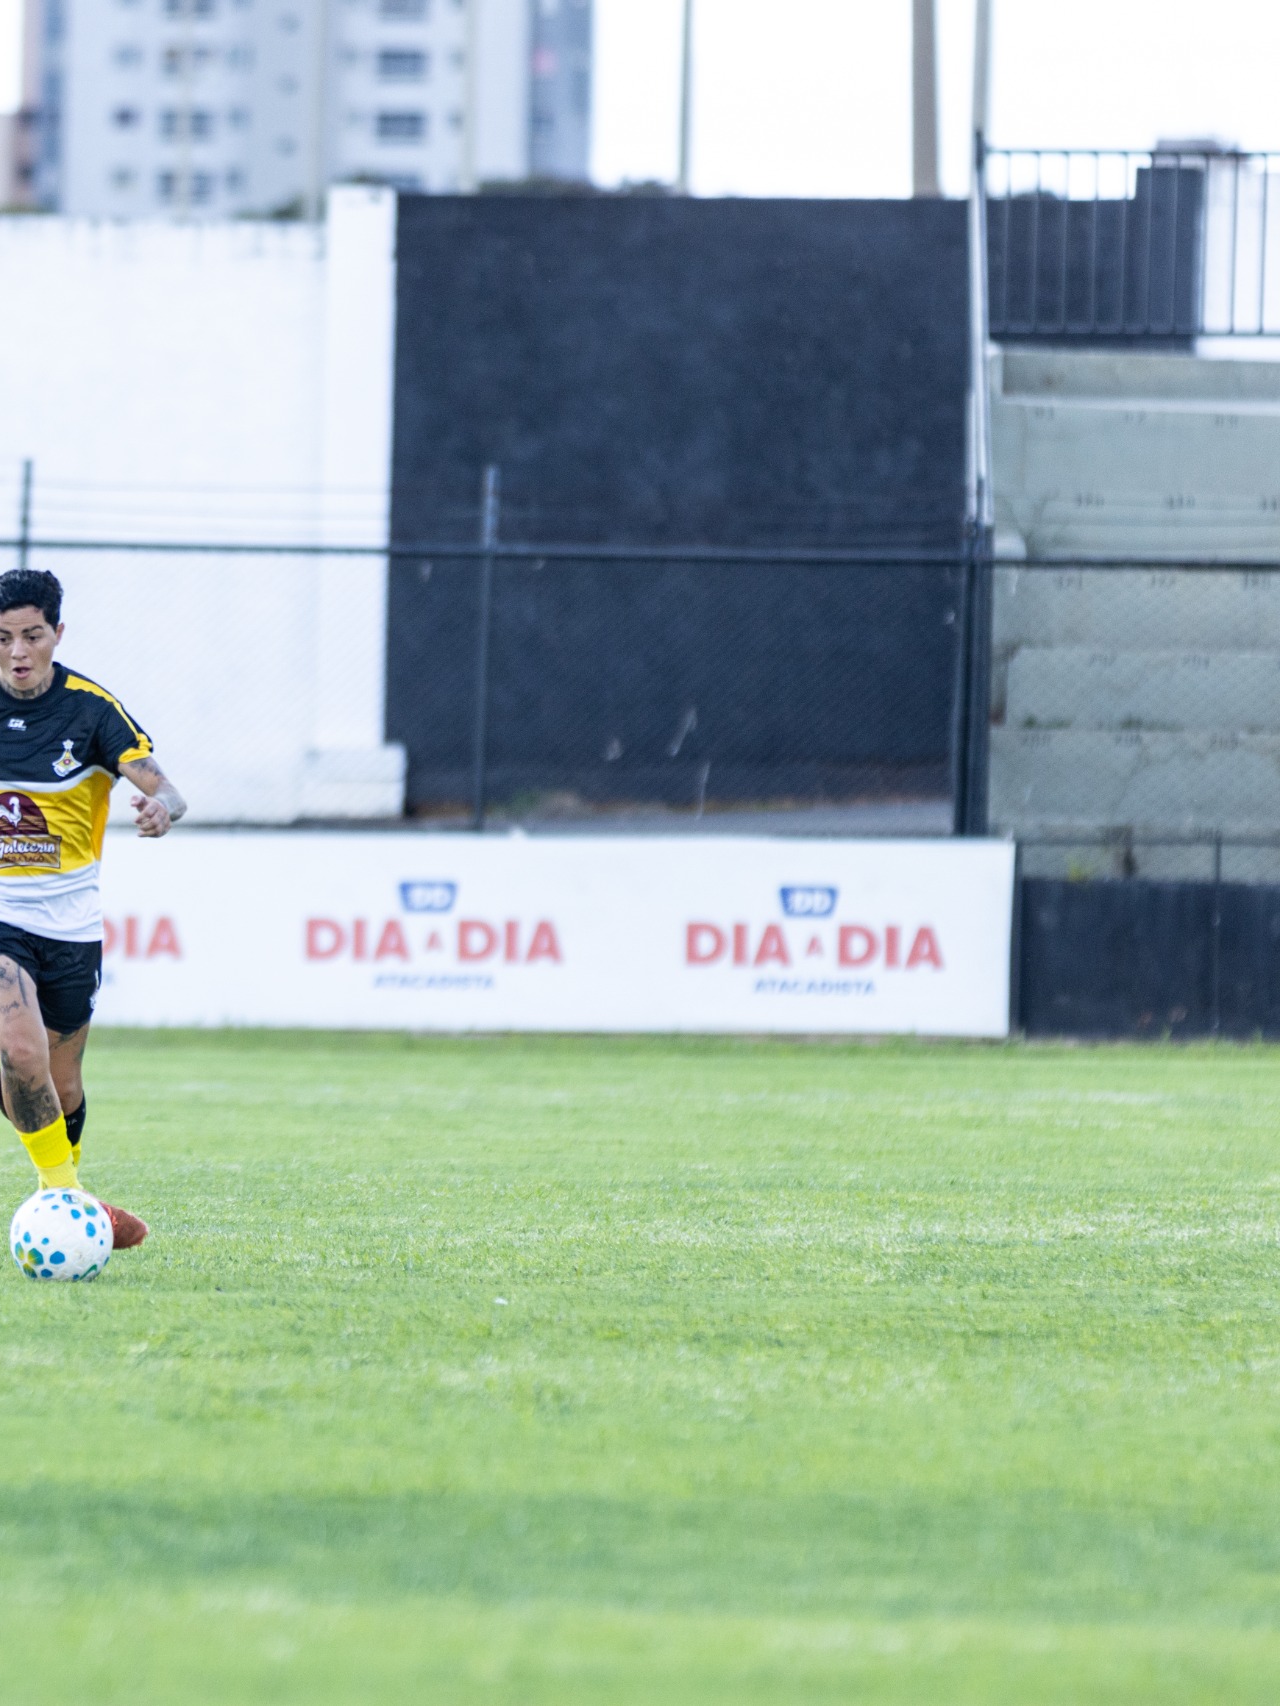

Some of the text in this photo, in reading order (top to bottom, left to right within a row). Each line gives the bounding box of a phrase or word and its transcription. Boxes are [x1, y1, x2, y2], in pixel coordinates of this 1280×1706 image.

[306, 918, 562, 963] DIA A DIA
[685, 922, 945, 970] DIA A DIA
[373, 974, 495, 990] ATACADISTA
[754, 977, 876, 996] ATACADISTA
